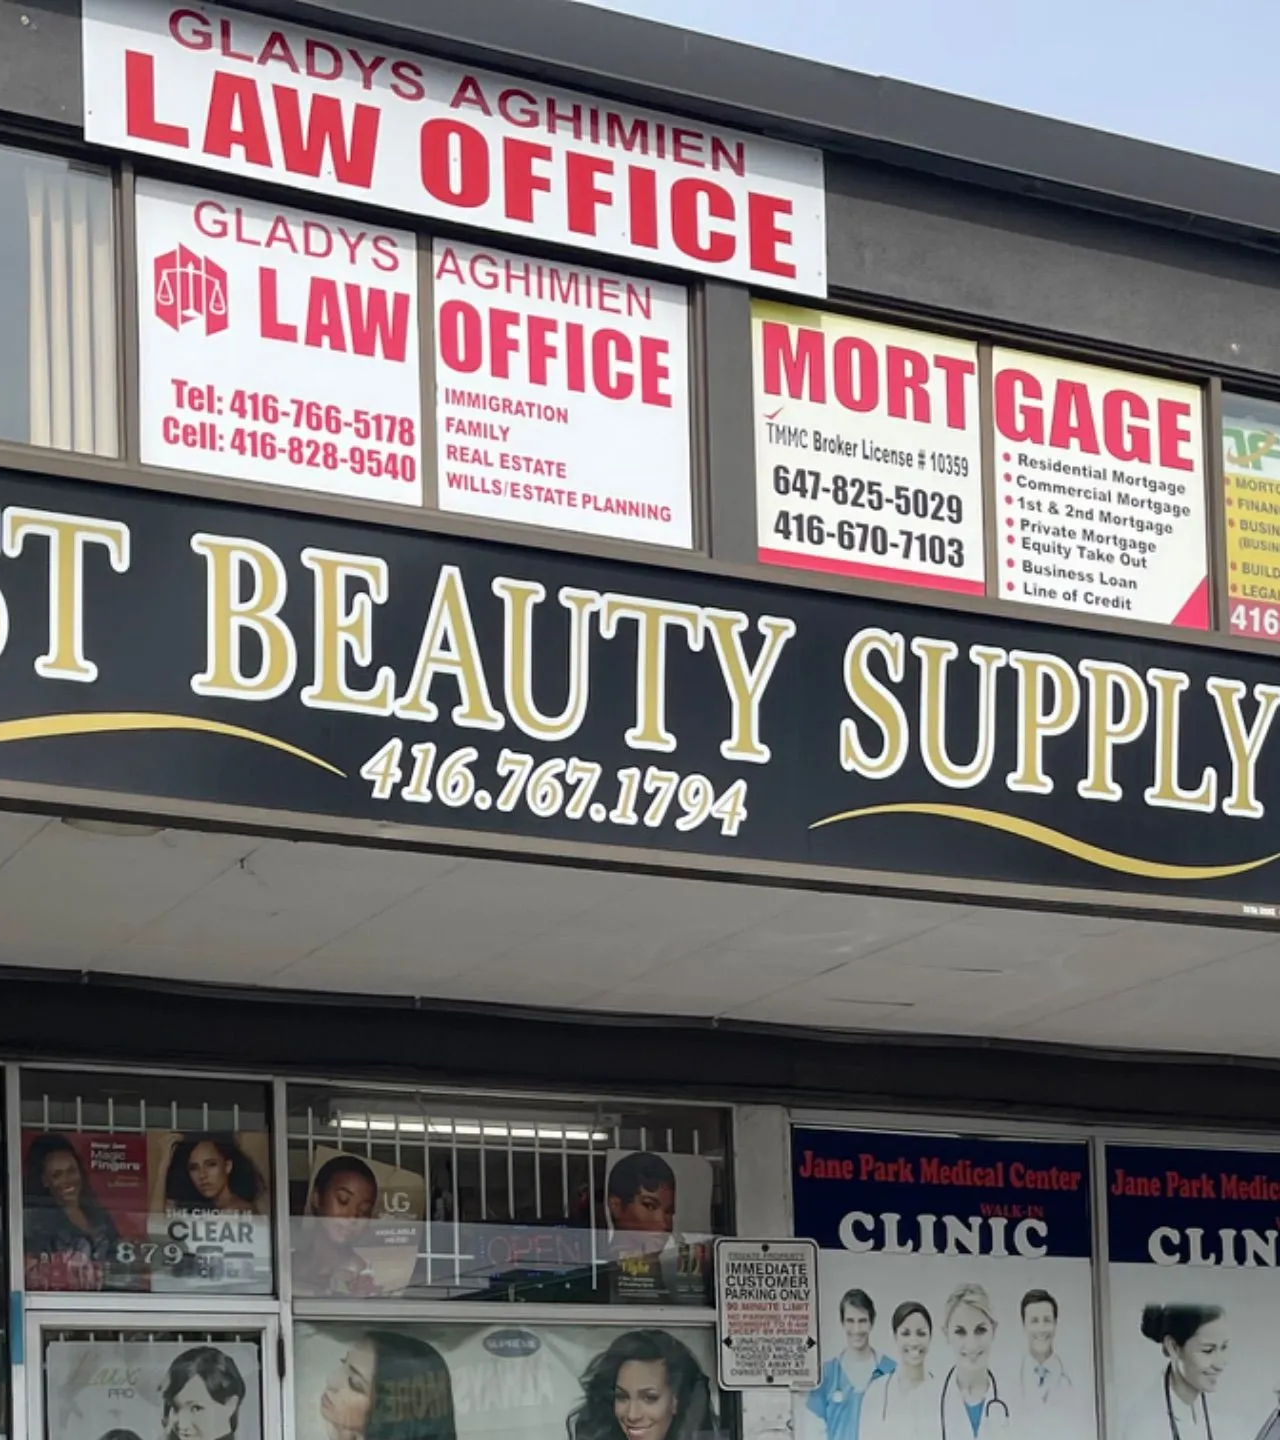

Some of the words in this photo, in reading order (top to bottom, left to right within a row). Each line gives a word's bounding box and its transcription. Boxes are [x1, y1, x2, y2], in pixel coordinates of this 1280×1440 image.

[168, 8, 425, 101] GLADYS
[450, 74, 746, 176] AGHIMIEN
[124, 49, 381, 189] LAW
[420, 117, 797, 279] OFFICE
[193, 200, 400, 272] GLADYS
[434, 247, 652, 319] AGHIMIEN
[257, 266, 411, 363] LAW
[439, 299, 673, 408] OFFICE
[170, 377, 223, 416] Tel:
[229, 388, 416, 446] 416-766-5178
[444, 387, 569, 424] IMMIGRATION
[162, 416, 224, 452] Cell:
[229, 427, 417, 483] 416-828-9540
[445, 417, 511, 442] FAMILY
[765, 422, 809, 449] TMMC
[812, 430, 859, 458] Broker
[861, 439, 914, 469] License
[930, 452, 969, 478] 10359
[445, 444, 495, 469] REAL
[499, 451, 567, 479] ESTATE
[1018, 454, 1108, 481] Residential
[1112, 469, 1186, 496] Mortgage
[446, 473, 578, 508] WILLS/ESTATE
[581, 492, 672, 523] PLANNING
[772, 464, 963, 525] 647-825-5029
[1017, 475, 1112, 504] Commercial
[1116, 492, 1191, 518] Mortgage
[1018, 496, 1042, 515] 1st
[1046, 500, 1060, 516] &
[1064, 503, 1094, 523] 2nd
[1099, 507, 1173, 536] Mortgage
[1020, 517, 1076, 541] Private
[1081, 528, 1157, 555] Mortgage
[774, 509, 965, 569] 416-670-7103
[1021, 536, 1072, 562] Equity
[1077, 545, 1115, 566] Take
[1119, 552, 1147, 569] Out
[1022, 559, 1095, 586] Business
[1099, 571, 1138, 590] Loan
[1023, 582, 1057, 601] Line
[1061, 587, 1079, 604] of
[1083, 590, 1132, 611] Credit
[187, 530, 796, 764] BEAUTY
[361, 735, 750, 841] 416.767.1794
[798, 1149, 852, 1181] Jane
[859, 1154, 913, 1184] Park
[919, 1157, 1004, 1188] Medical
[1008, 1161, 1081, 1192] Center
[1111, 1168, 1157, 1197] Jane
[1163, 1172, 1215, 1200] Park
[979, 1203, 1044, 1218] WALK-IN
[168, 1221, 254, 1243] CLEAR
[838, 1210, 1048, 1257] CLINIC
[116, 1242, 184, 1265] 879
[726, 1263, 807, 1275] IMMEDIATE
[726, 1276, 808, 1288] CUSTOMER
[726, 1288, 777, 1300] PARKING
[780, 1289, 810, 1301] ONLY
